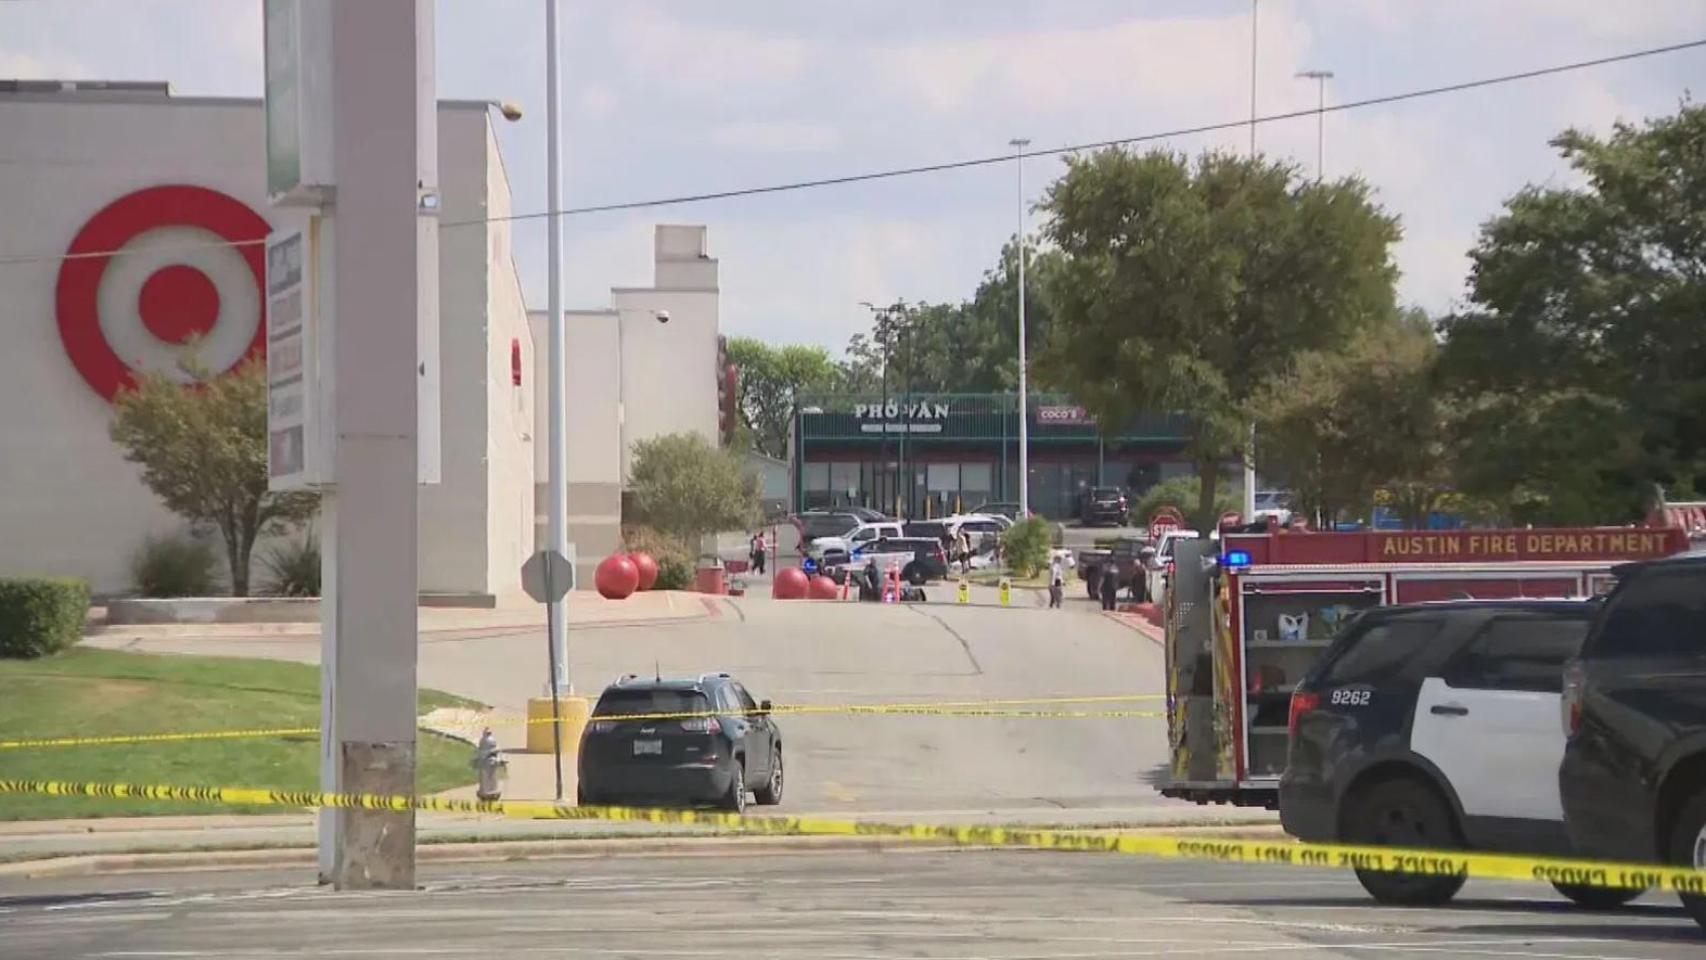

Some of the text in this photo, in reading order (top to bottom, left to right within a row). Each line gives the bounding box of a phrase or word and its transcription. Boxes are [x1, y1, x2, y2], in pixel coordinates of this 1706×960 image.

[1383, 533, 1667, 555] AUSTIN FIRE DEPARTMENT
[1331, 689, 1371, 705] 9262
